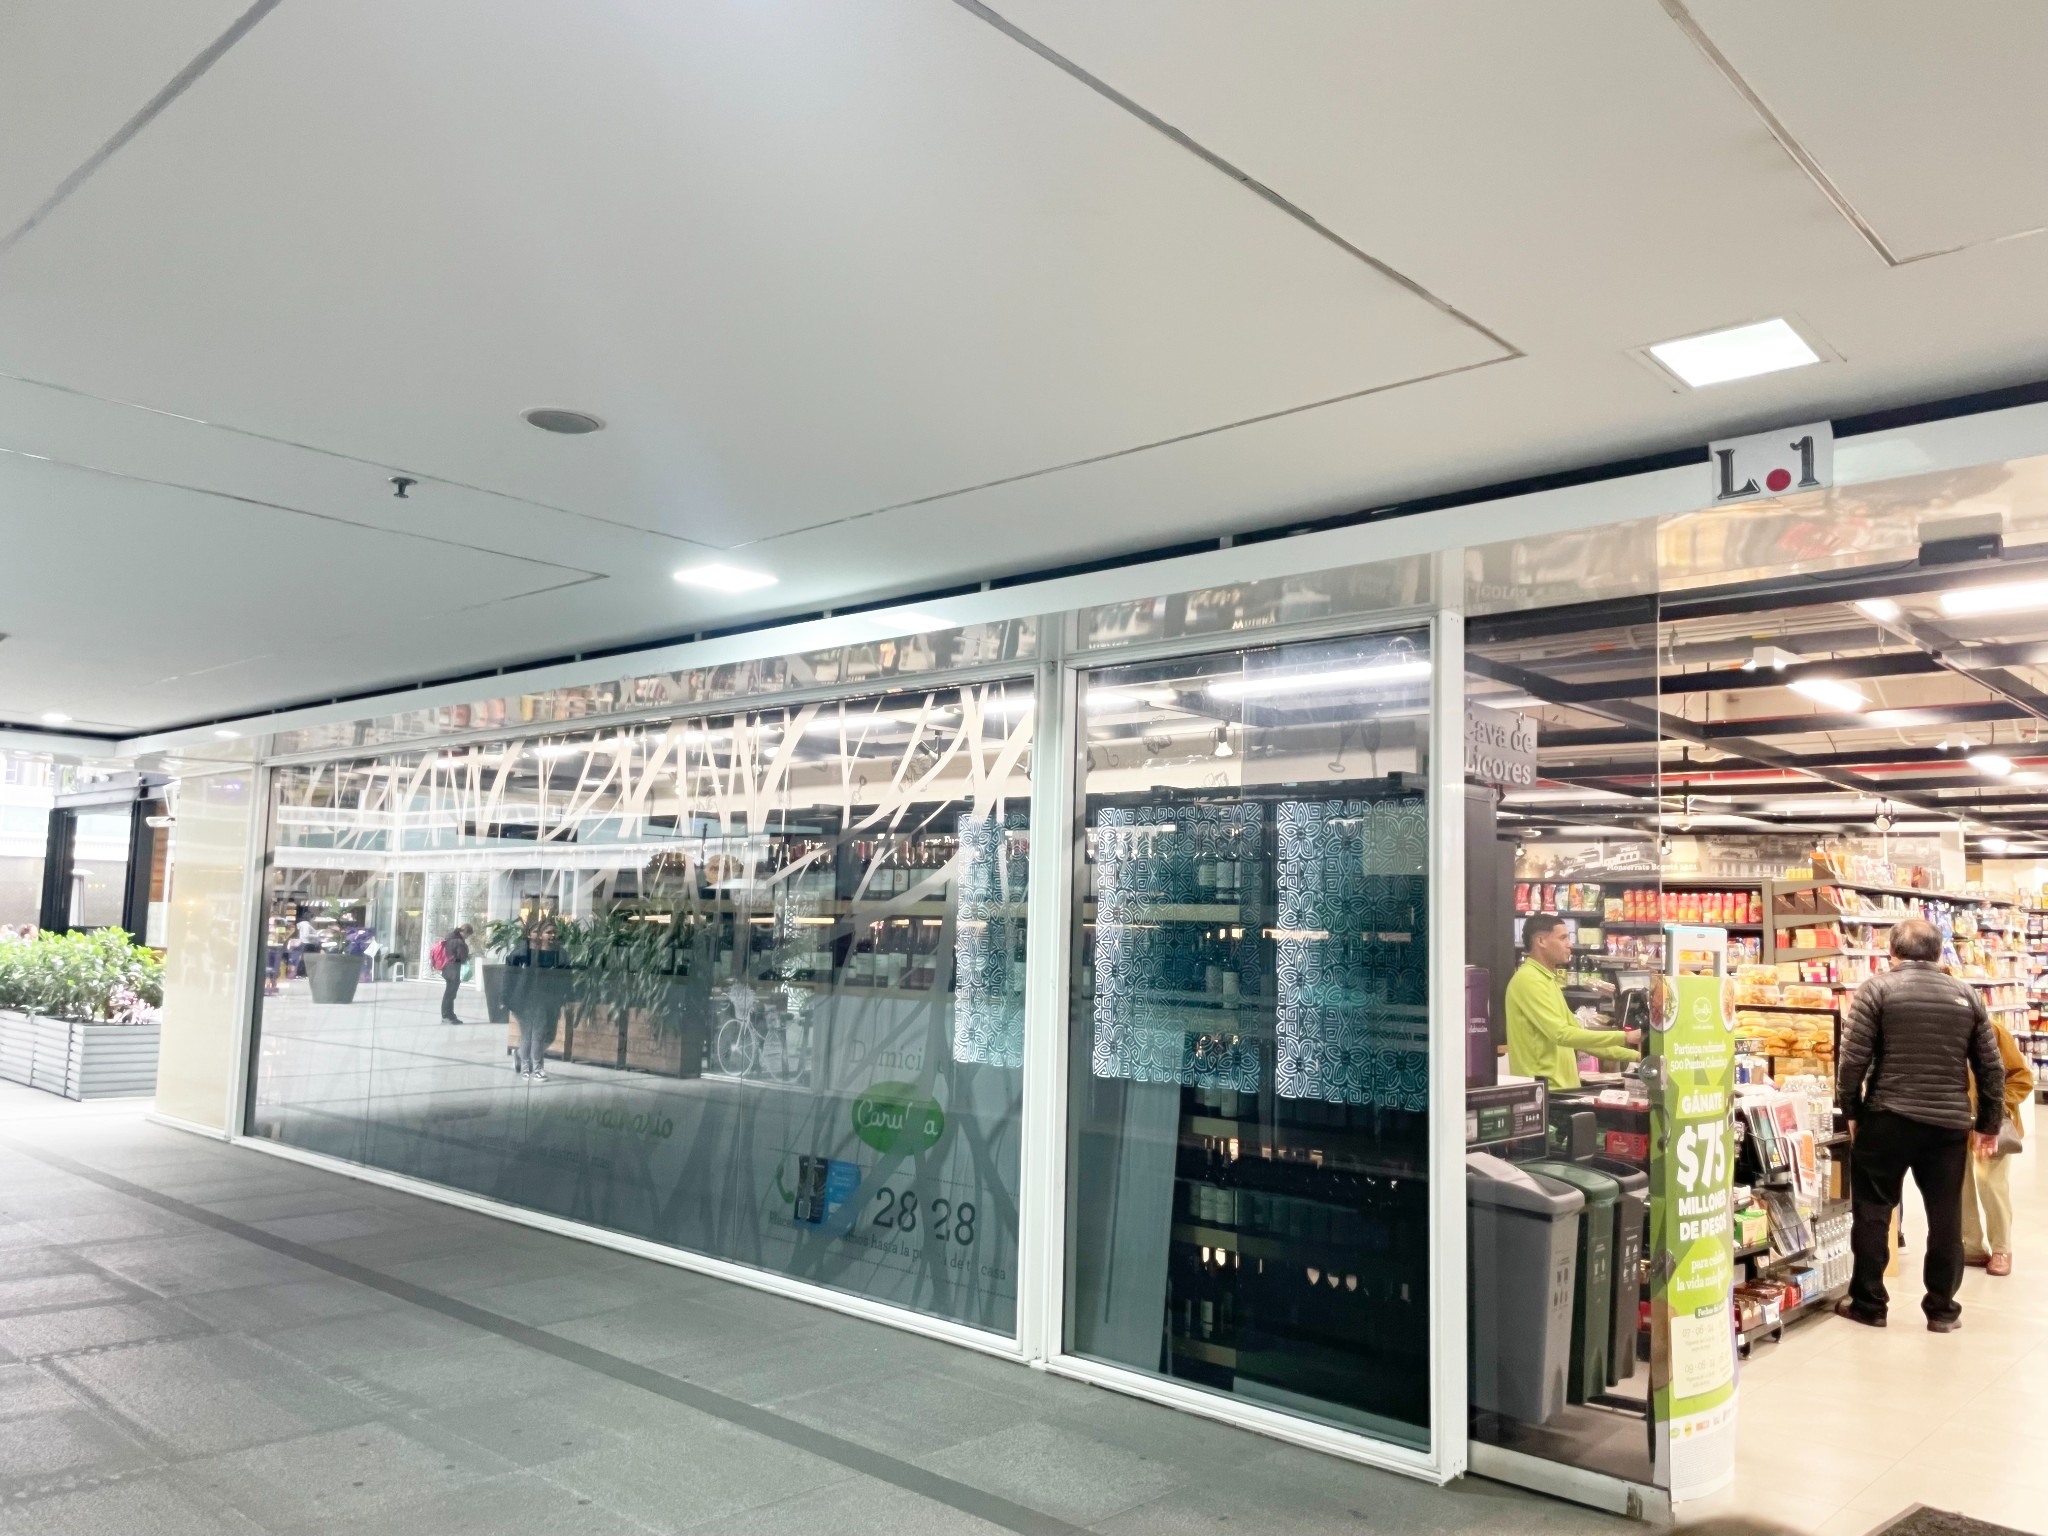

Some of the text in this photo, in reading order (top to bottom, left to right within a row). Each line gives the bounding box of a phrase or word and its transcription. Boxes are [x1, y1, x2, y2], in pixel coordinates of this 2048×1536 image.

[1511, 714, 1535, 754] de
[1464, 744, 1532, 785] Licores
[1681, 1089, 1723, 1115] GÁNATE
[1677, 1119, 1725, 1192] $75
[1678, 1188, 1726, 1217] MILLONES
[1679, 1220, 1700, 1241] DE
[981, 1265, 1006, 1281] casa
[1686, 1274, 1704, 1290] vida
